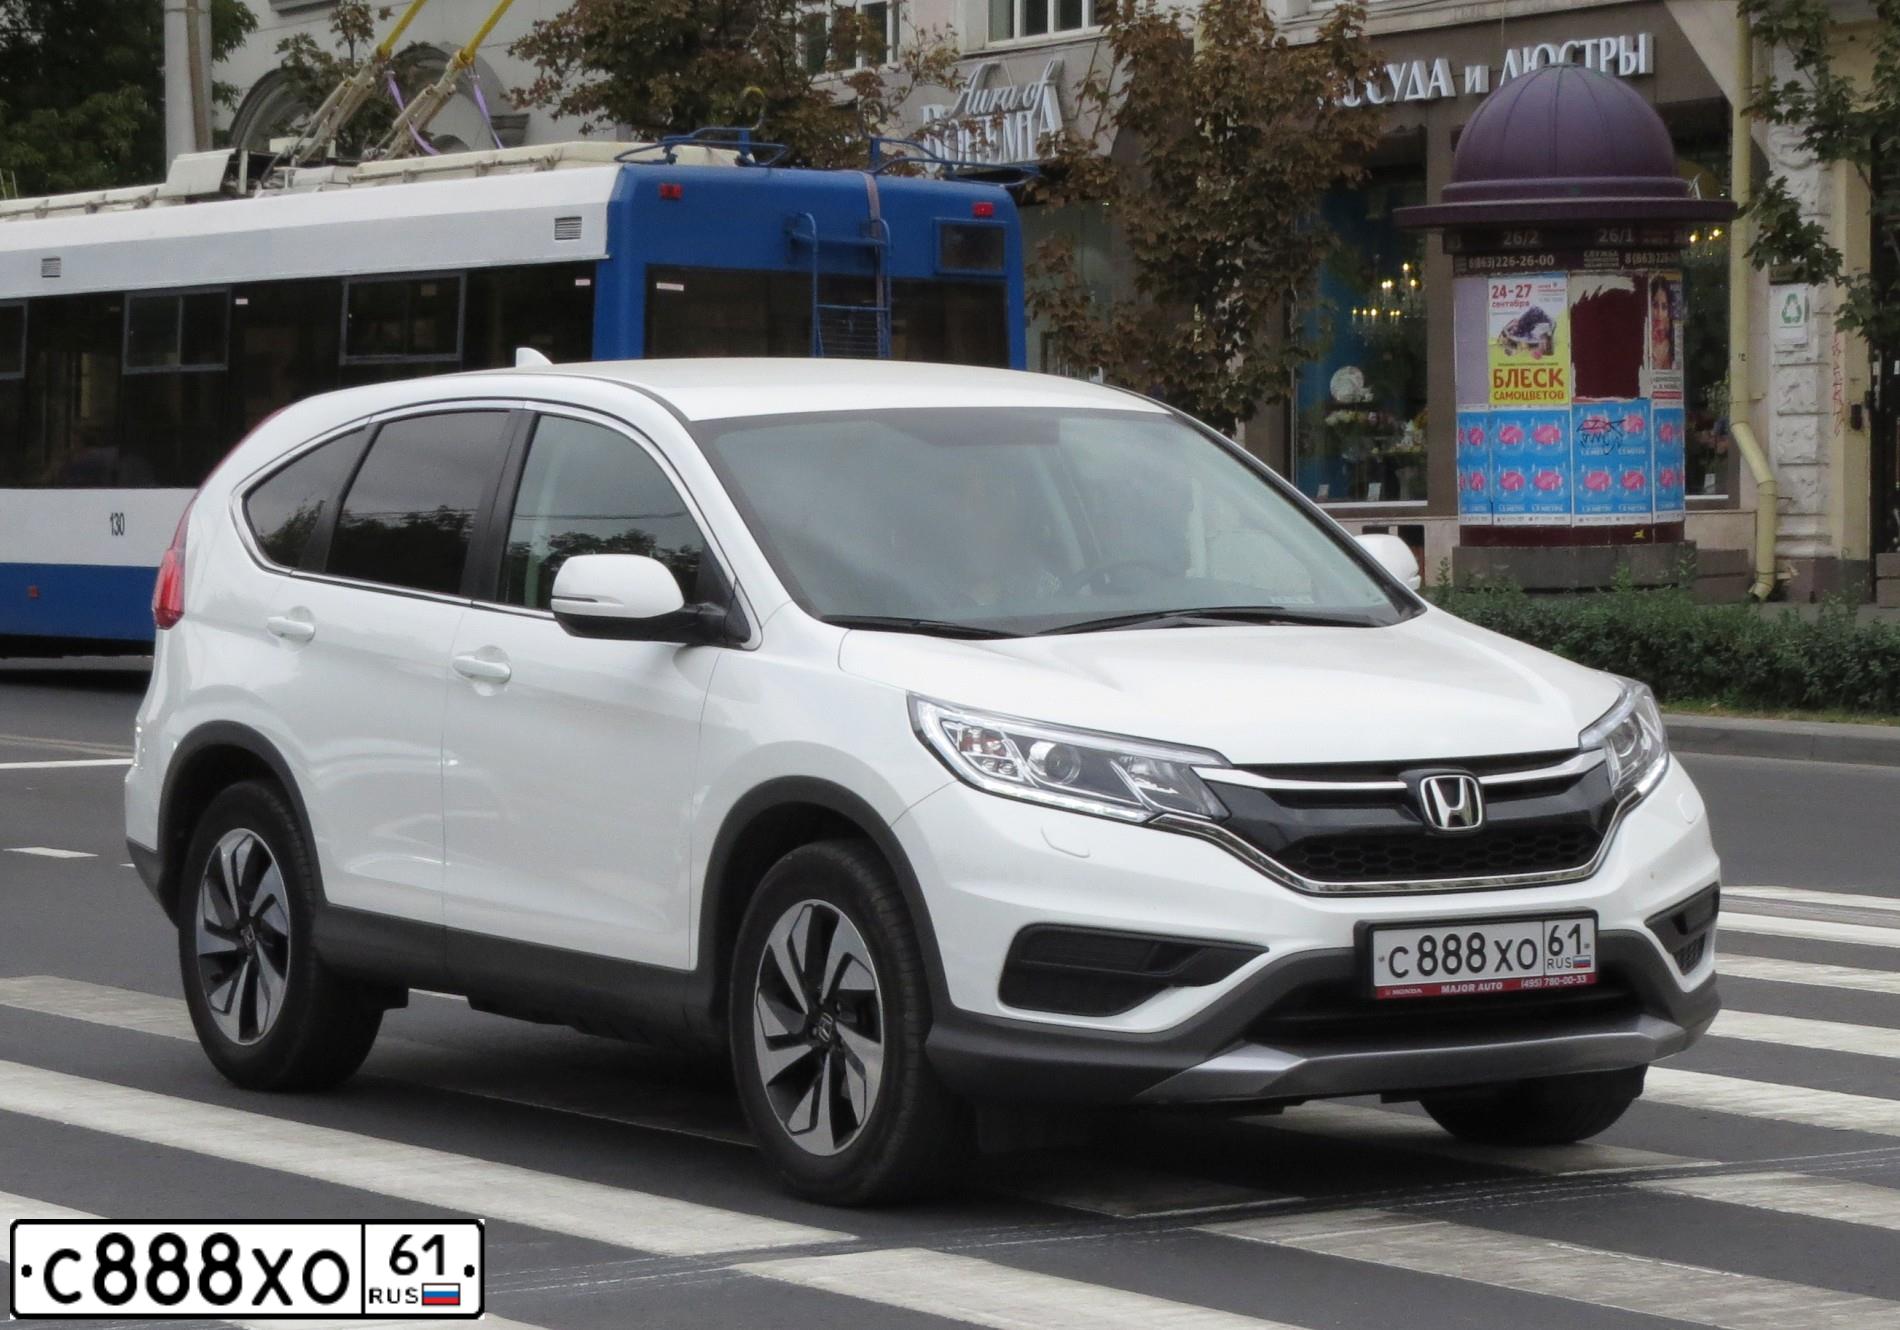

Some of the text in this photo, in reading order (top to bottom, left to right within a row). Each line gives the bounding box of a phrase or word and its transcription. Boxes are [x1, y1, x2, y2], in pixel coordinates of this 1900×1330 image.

[950, 58, 1063, 116] Aura of
[1465, 65, 1490, 95] и
[1493, 368, 1564, 388] БЛЕСК
[1493, 391, 1564, 401] САМОЦВЕТОВ
[109, 512, 125, 536] 130
[1547, 923, 1582, 957] 61
[1547, 956, 1572, 969] RUS
[1441, 981, 1503, 994] MAJOR AUTO
[1520, 977, 1542, 989] (495)
